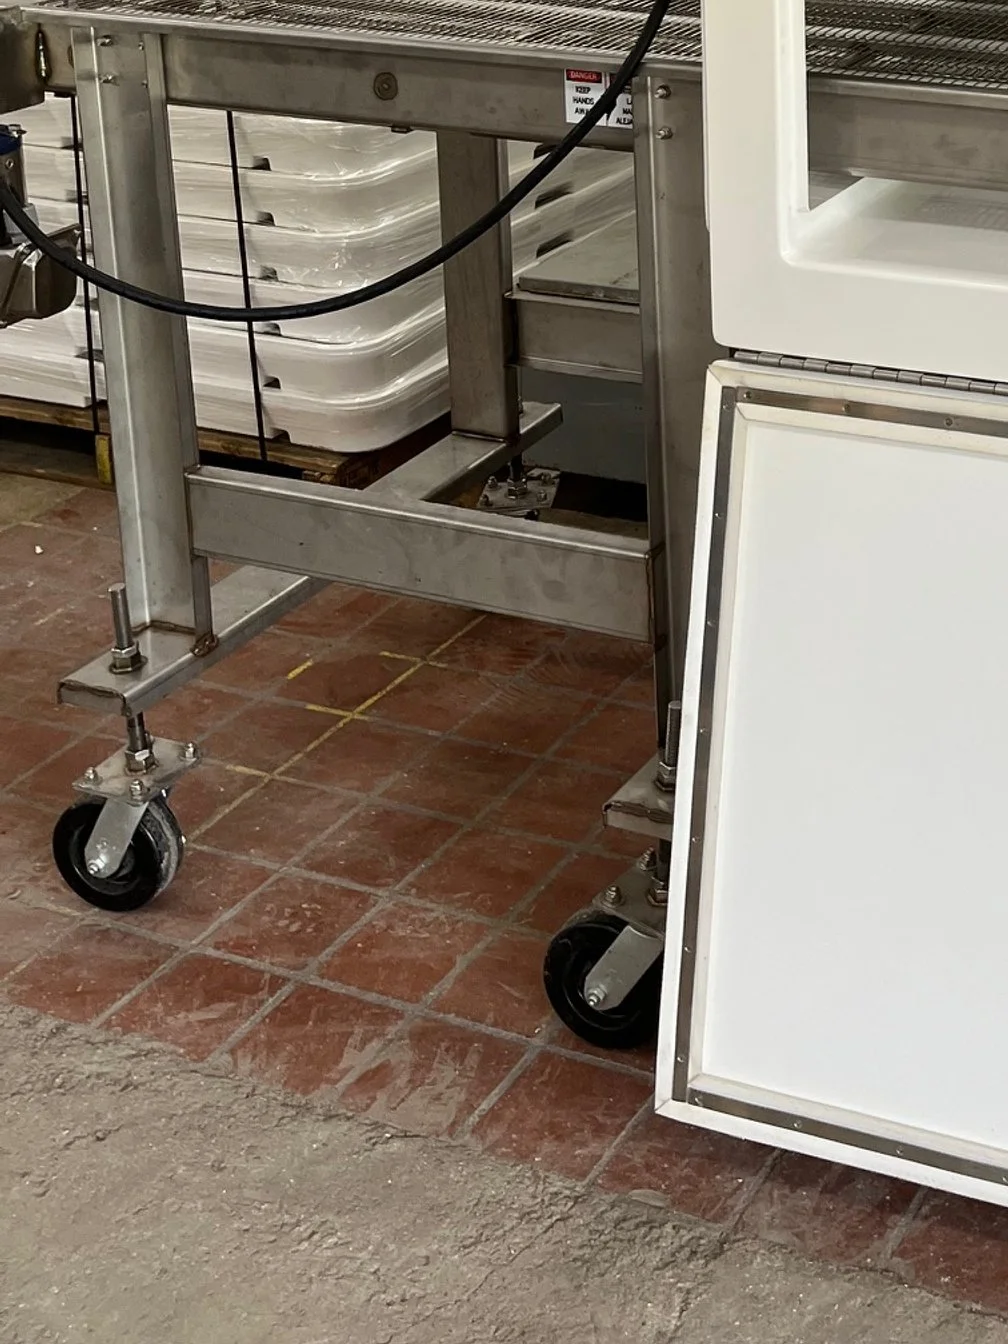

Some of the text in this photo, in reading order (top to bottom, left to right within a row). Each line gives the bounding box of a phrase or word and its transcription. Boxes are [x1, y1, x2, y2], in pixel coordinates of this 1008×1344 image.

[570, 70, 597, 80] DANGER
[575, 86, 591, 94] KEEP
[572, 97, 594, 105] HANDS
[574, 107, 589, 115] AW
